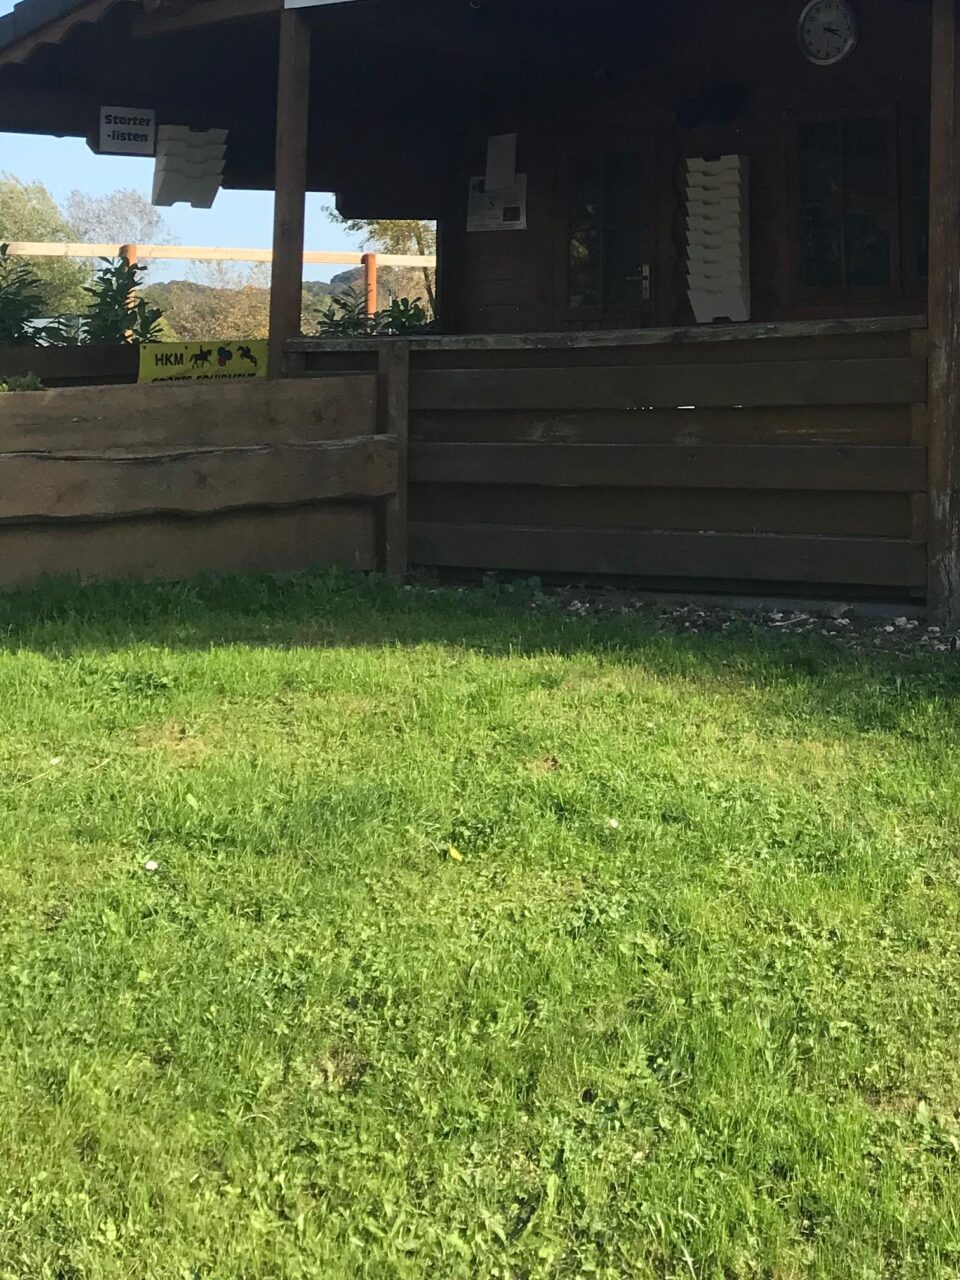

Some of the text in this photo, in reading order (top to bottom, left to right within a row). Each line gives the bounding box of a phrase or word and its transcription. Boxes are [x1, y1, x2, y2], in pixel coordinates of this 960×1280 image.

[104, 114, 152, 127] Starter
[107, 130, 148, 142] -listen
[154, 352, 184, 367] HKM
